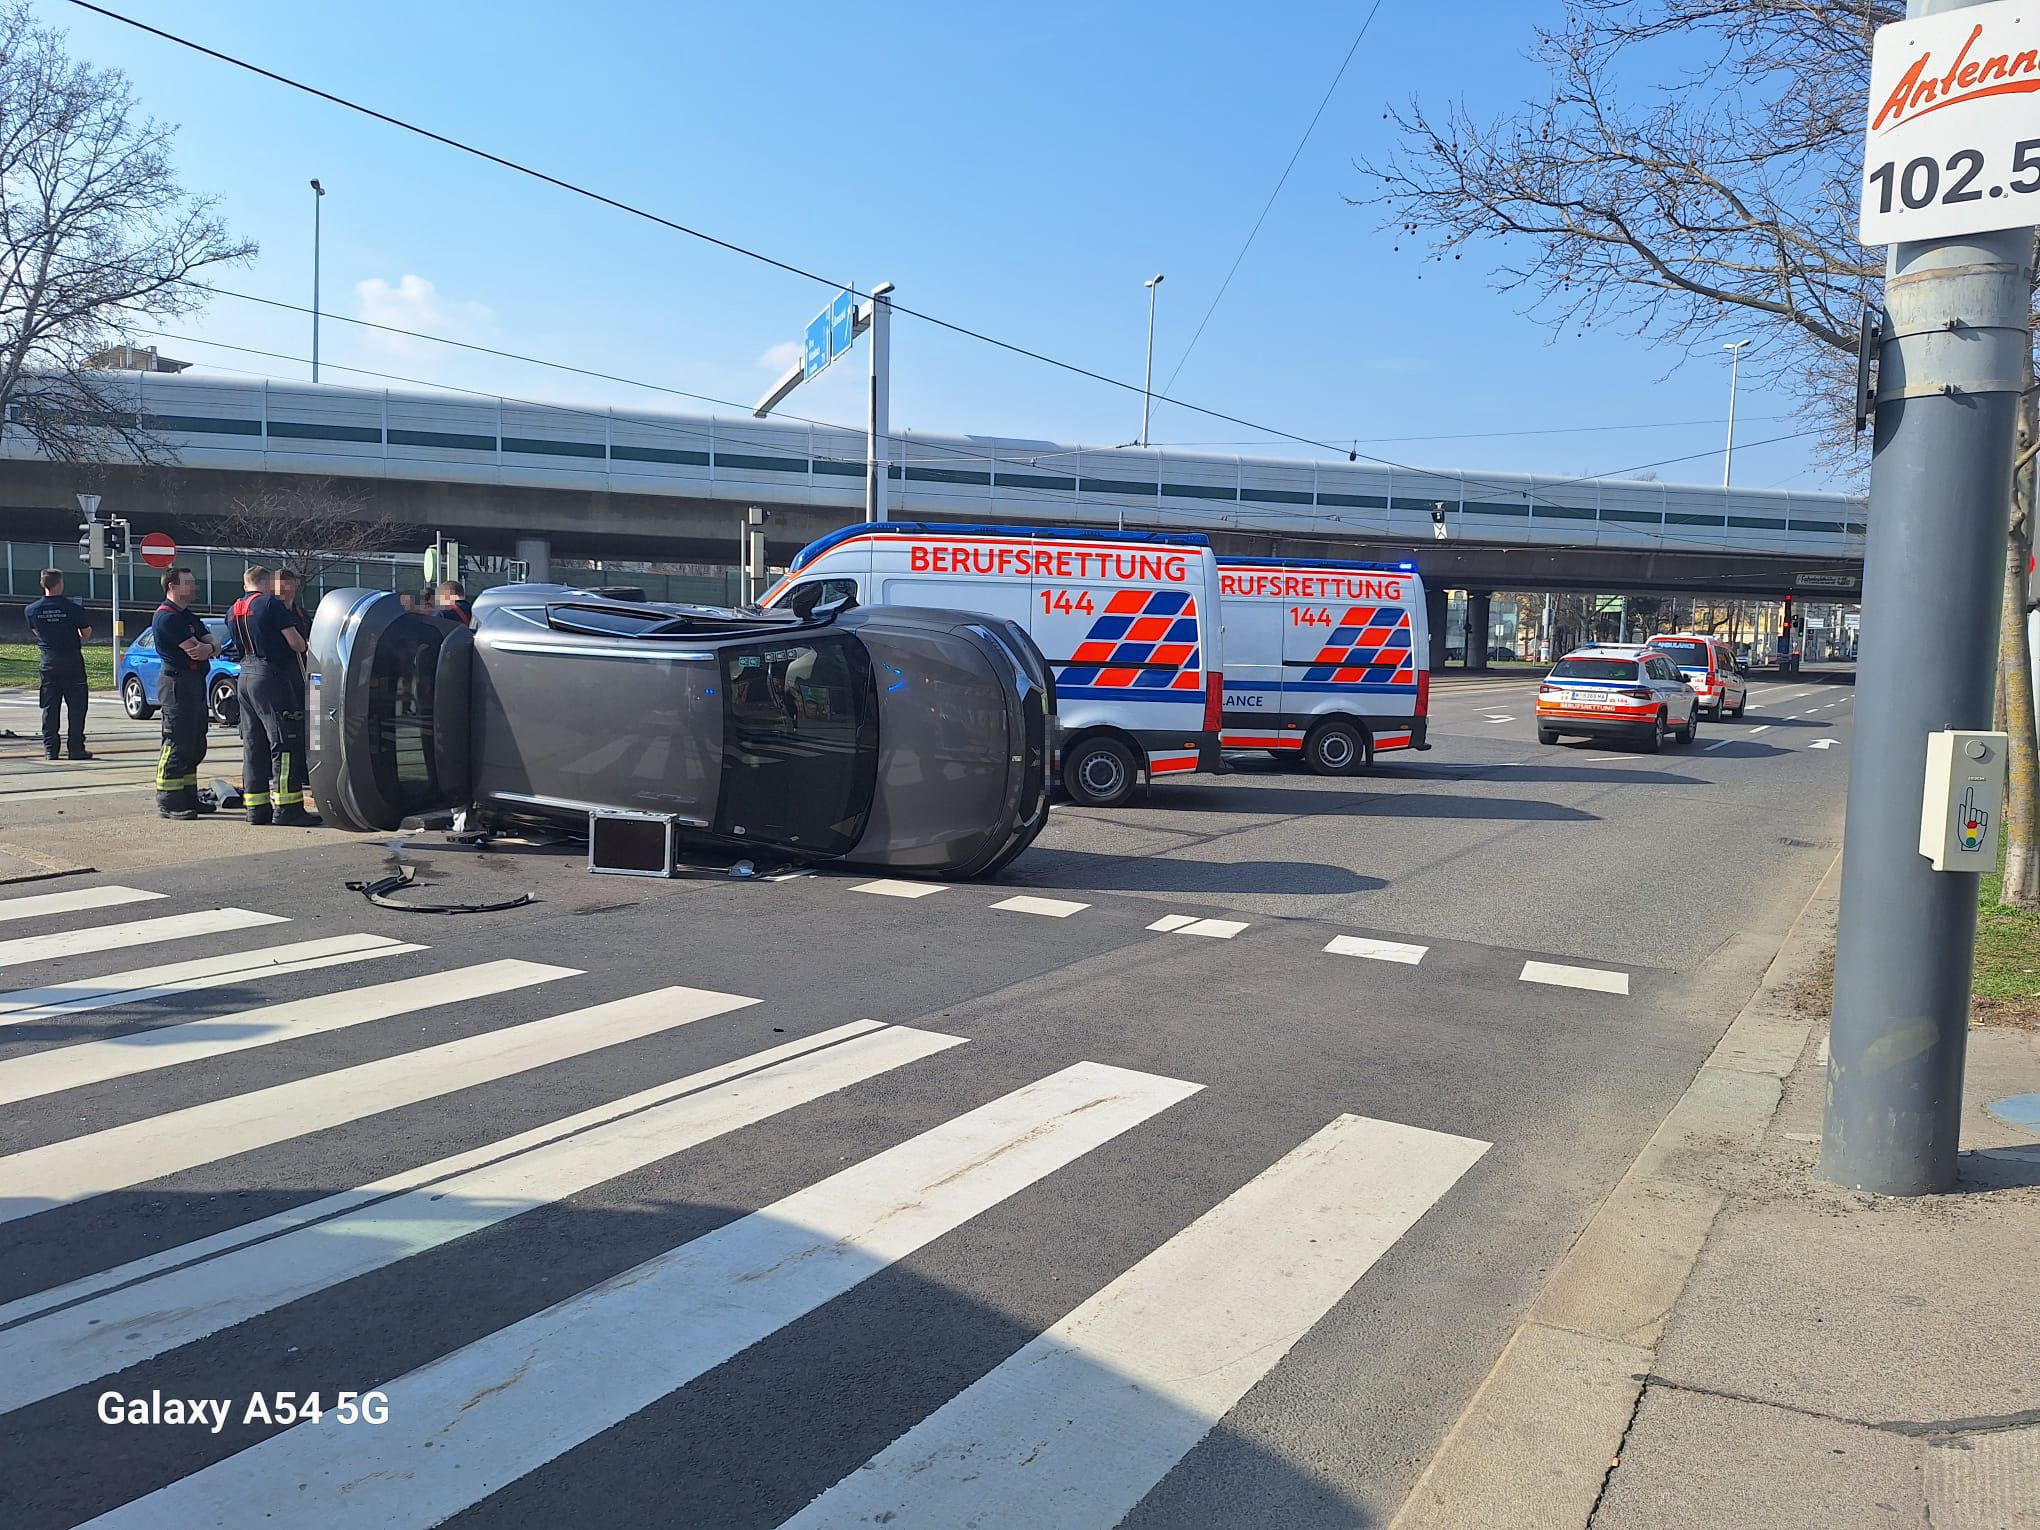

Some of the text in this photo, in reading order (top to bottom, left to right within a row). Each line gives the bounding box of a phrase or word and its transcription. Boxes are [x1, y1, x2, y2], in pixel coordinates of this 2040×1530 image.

[1872, 23, 2040, 131] Antenn
[1869, 138, 2040, 214] 102.5
[910, 546, 1186, 582] BERUFSRETTUNG
[1221, 575, 1401, 600] RUFSRETTUNG
[1040, 589, 1094, 616] 144
[1290, 607, 1332, 627] 144
[1560, 702, 1616, 712] BERUFSRETTUNG
